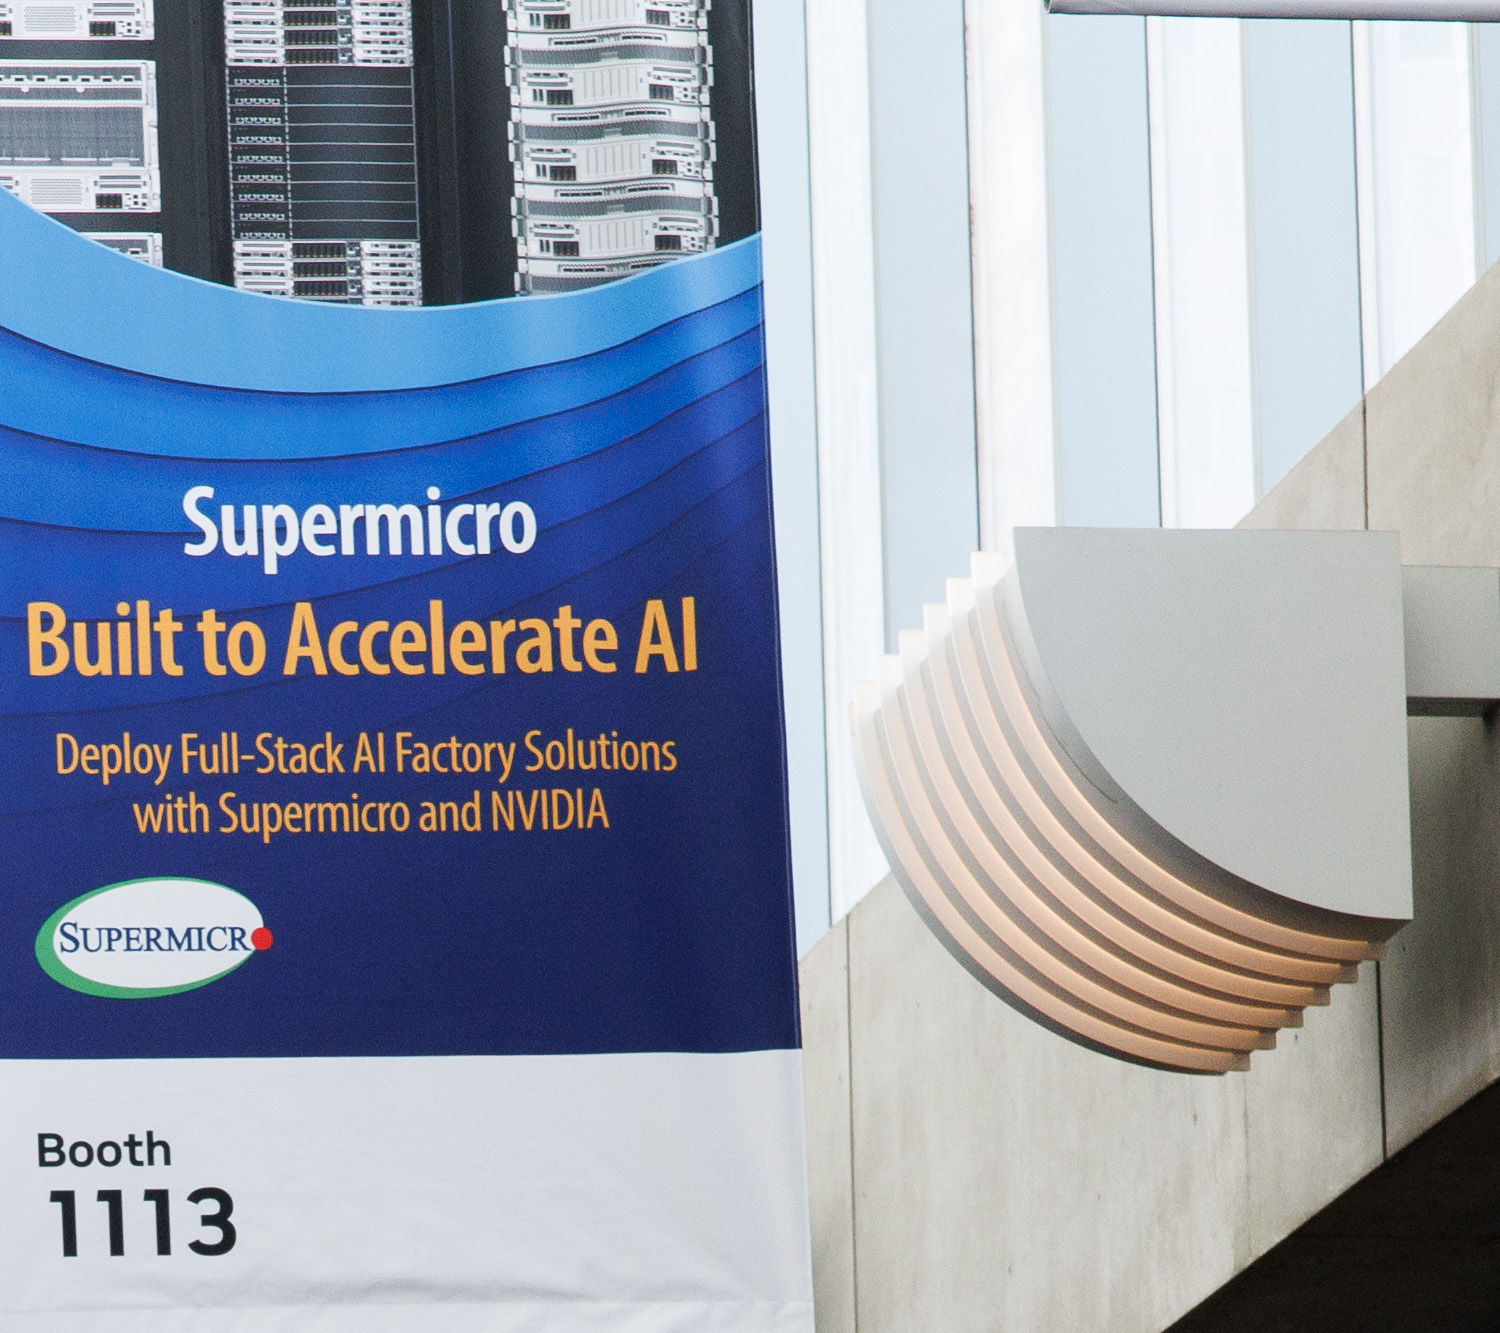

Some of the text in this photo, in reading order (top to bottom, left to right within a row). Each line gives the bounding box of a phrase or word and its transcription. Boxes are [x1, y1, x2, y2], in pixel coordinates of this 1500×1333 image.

[183, 485, 537, 573] Supermicro
[26, 594, 699, 678] Built to Accelerate AI
[55, 726, 678, 789] Deploy Full-Stack AI Factory Solutions
[132, 788, 610, 843] with Supermicro and NVIDIA
[36, 1130, 173, 1170] Booth
[49, 1187, 239, 1259] 1113
